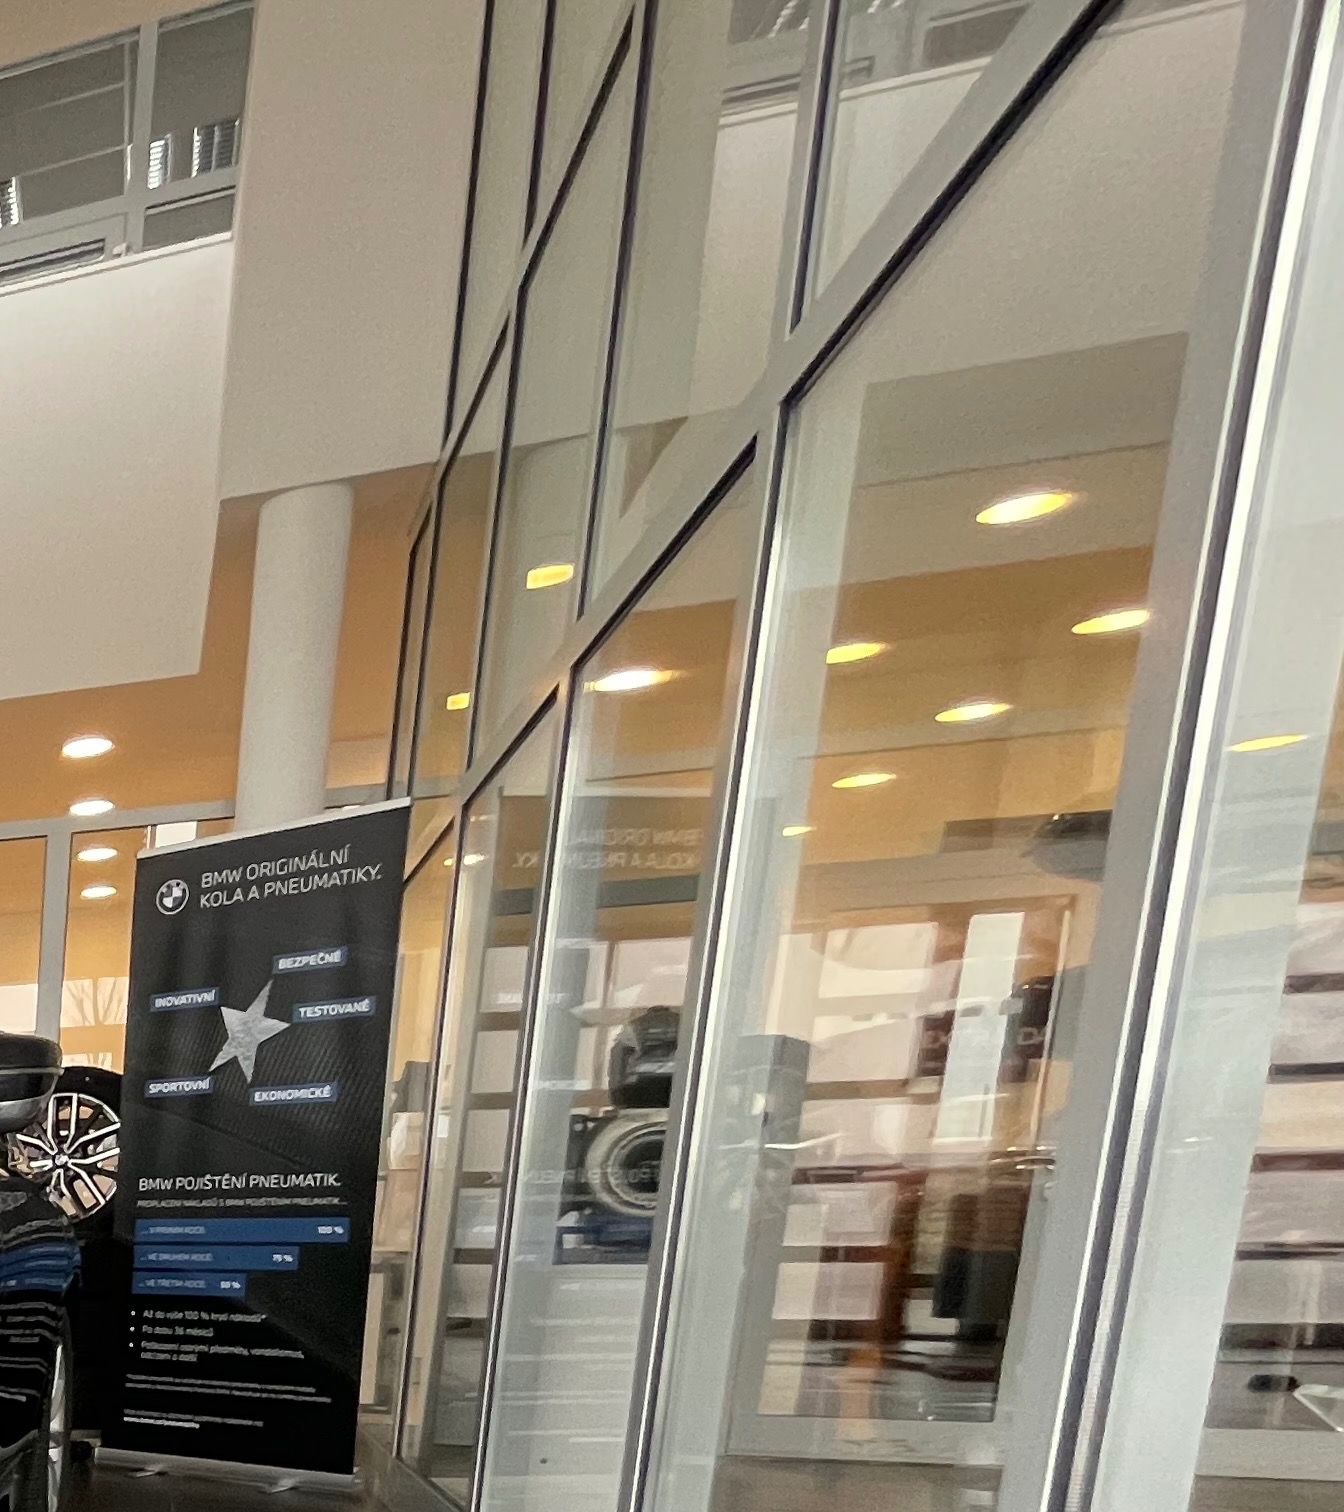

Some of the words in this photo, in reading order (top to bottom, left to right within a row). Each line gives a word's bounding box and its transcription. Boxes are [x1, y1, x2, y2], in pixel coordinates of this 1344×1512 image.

[201, 866, 243, 889] BMW
[246, 844, 351, 881] ORIGINÁLNÍ
[200, 887, 244, 908] KOLA
[247, 885, 260, 901] A
[264, 863, 382, 898] PNEUMATIKY.
[299, 998, 370, 1018] TESTOVANÉ
[139, 1177, 174, 1191] BMW
[175, 1172, 247, 1191] POJIŠTĚNÍ
